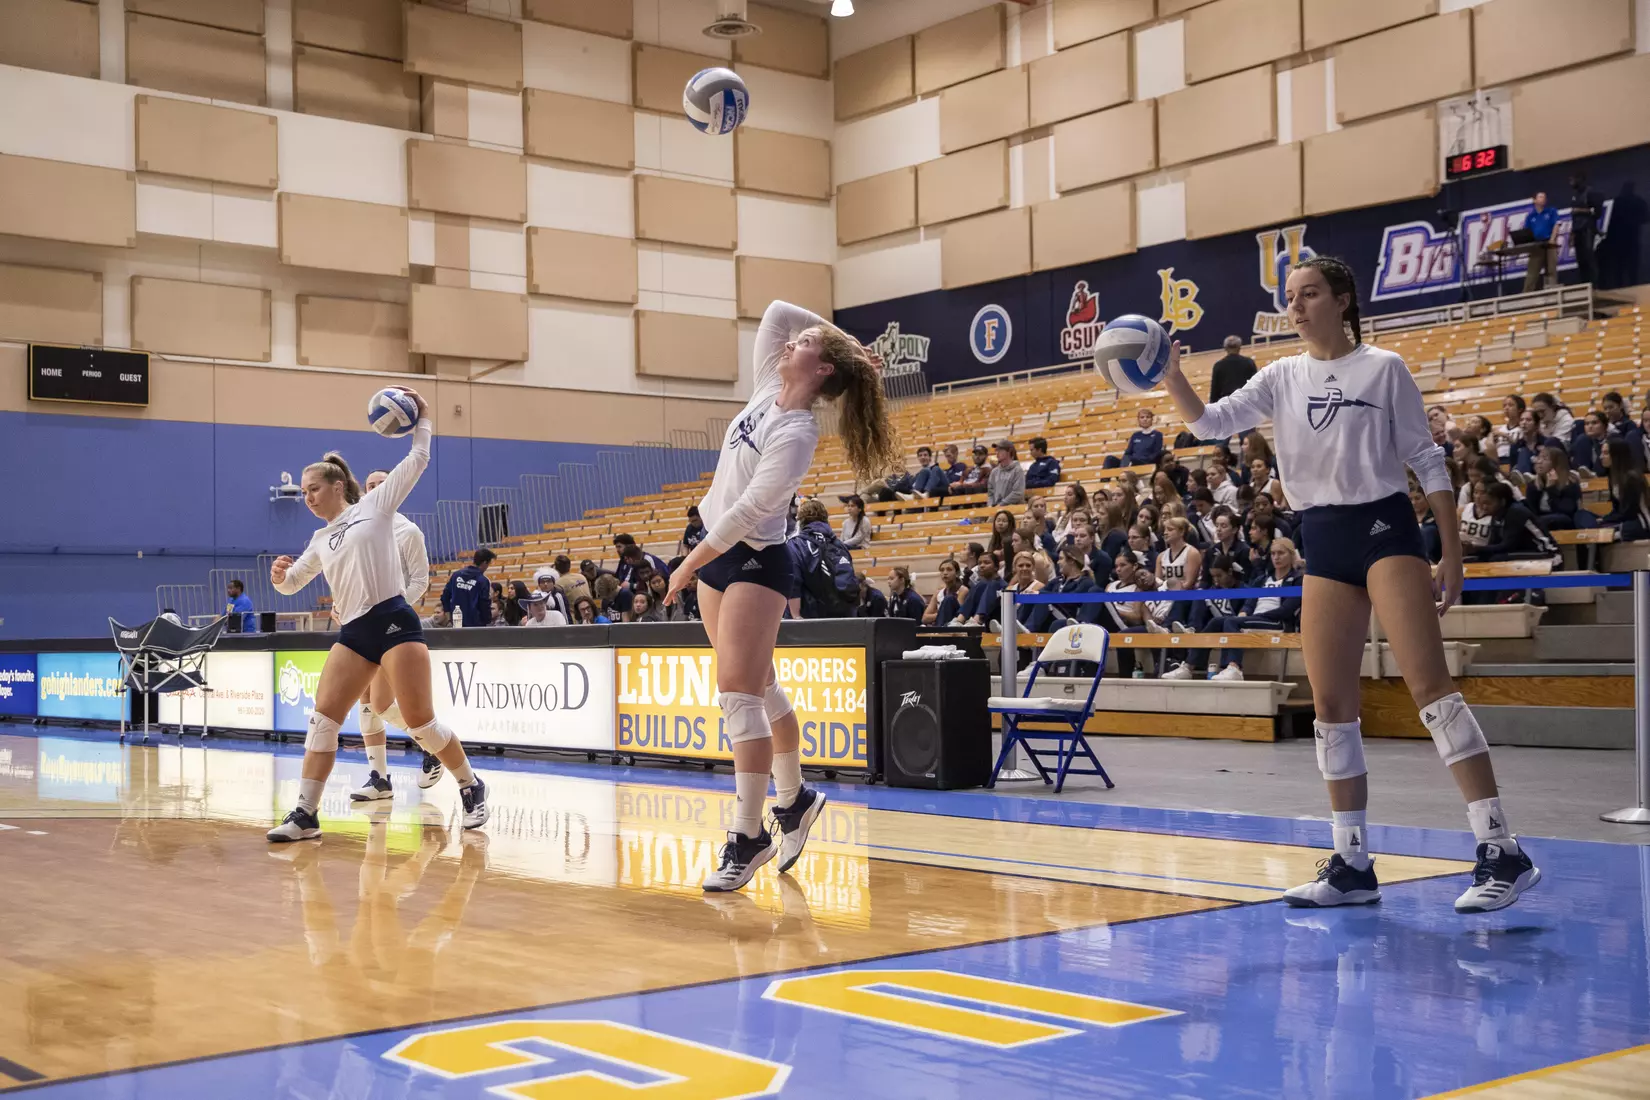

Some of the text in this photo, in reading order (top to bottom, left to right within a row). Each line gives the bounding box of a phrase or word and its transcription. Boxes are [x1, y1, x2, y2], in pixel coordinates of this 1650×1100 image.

[1157, 267, 1204, 336] LB
[984, 318, 998, 351] F
[899, 337, 929, 361] POLY
[41, 368, 62, 377] HOME
[82, 370, 102, 378] PERIOD
[119, 373, 142, 382] GUEST
[443, 662, 590, 711] WINDWOOD
[619, 713, 707, 750] BUILDS
